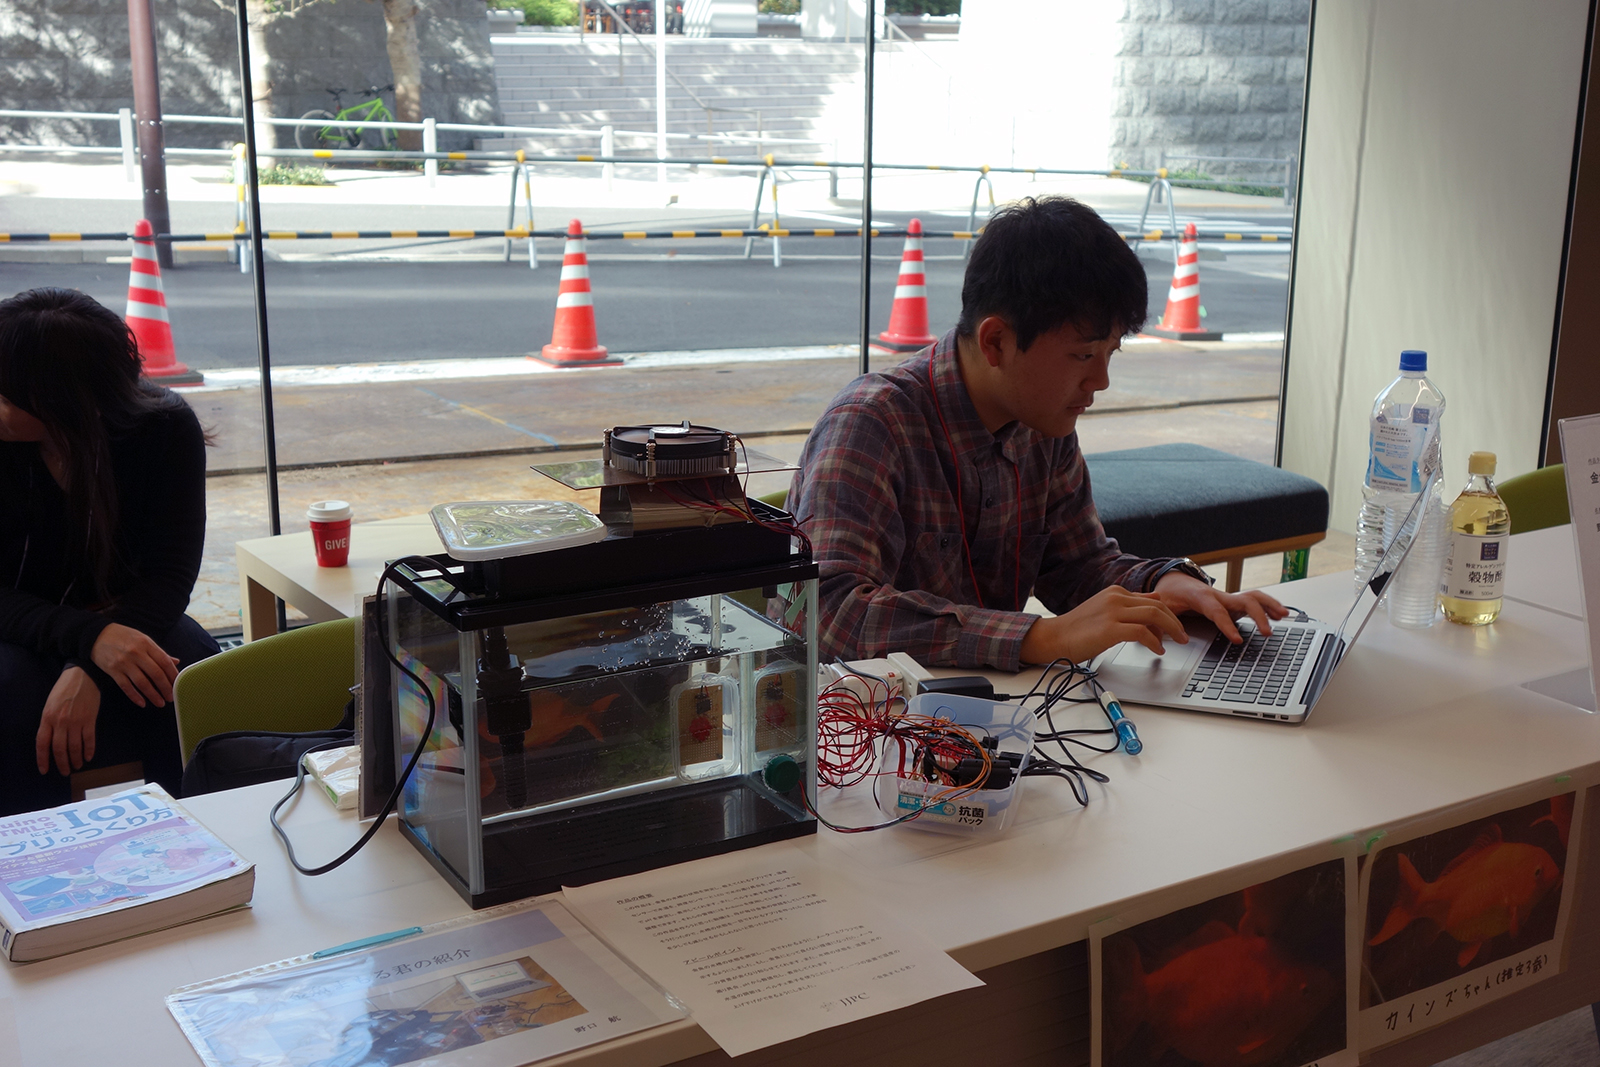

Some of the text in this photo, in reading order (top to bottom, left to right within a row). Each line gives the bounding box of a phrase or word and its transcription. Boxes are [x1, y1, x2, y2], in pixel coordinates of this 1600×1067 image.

[1590, 471, 1600, 484] 金
[325, 538, 347, 550] GIVE
[958, 806, 984, 819] 抗菌
[958, 817, 984, 826] パック
[683, 945, 745, 965] アピールポイント
[574, 1022, 597, 1033] 野口
